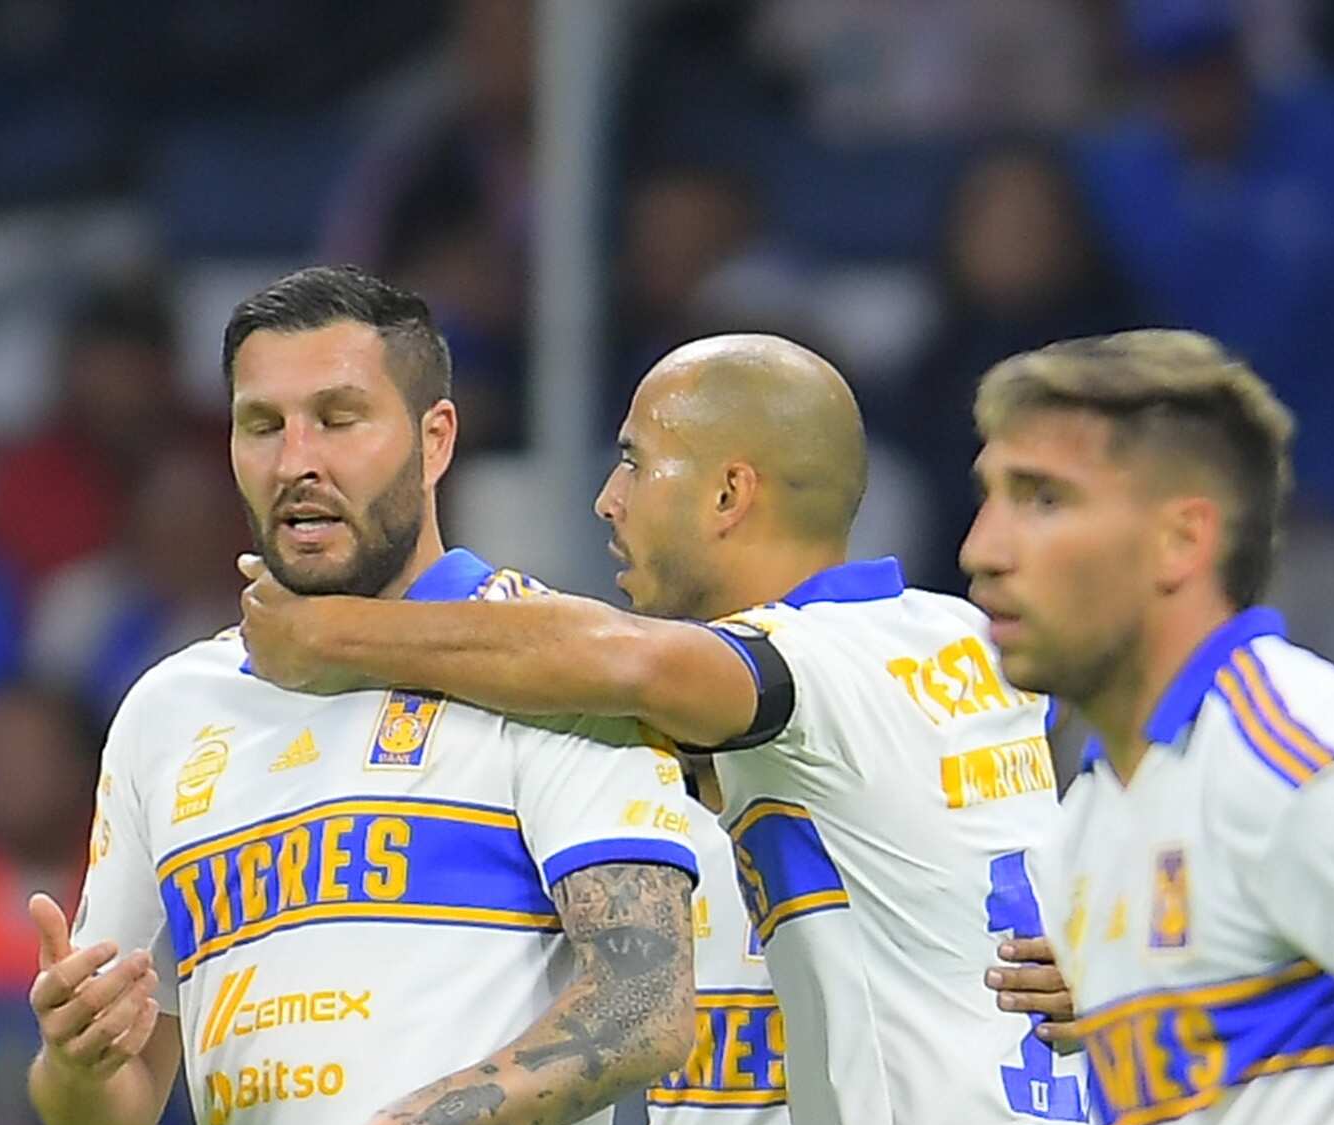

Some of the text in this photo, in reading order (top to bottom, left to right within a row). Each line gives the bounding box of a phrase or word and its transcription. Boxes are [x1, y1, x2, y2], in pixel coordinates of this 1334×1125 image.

[174, 816, 411, 947] TIGRES
[233, 990, 372, 1036] CEMEX
[236, 1060, 345, 1109] Bitso
